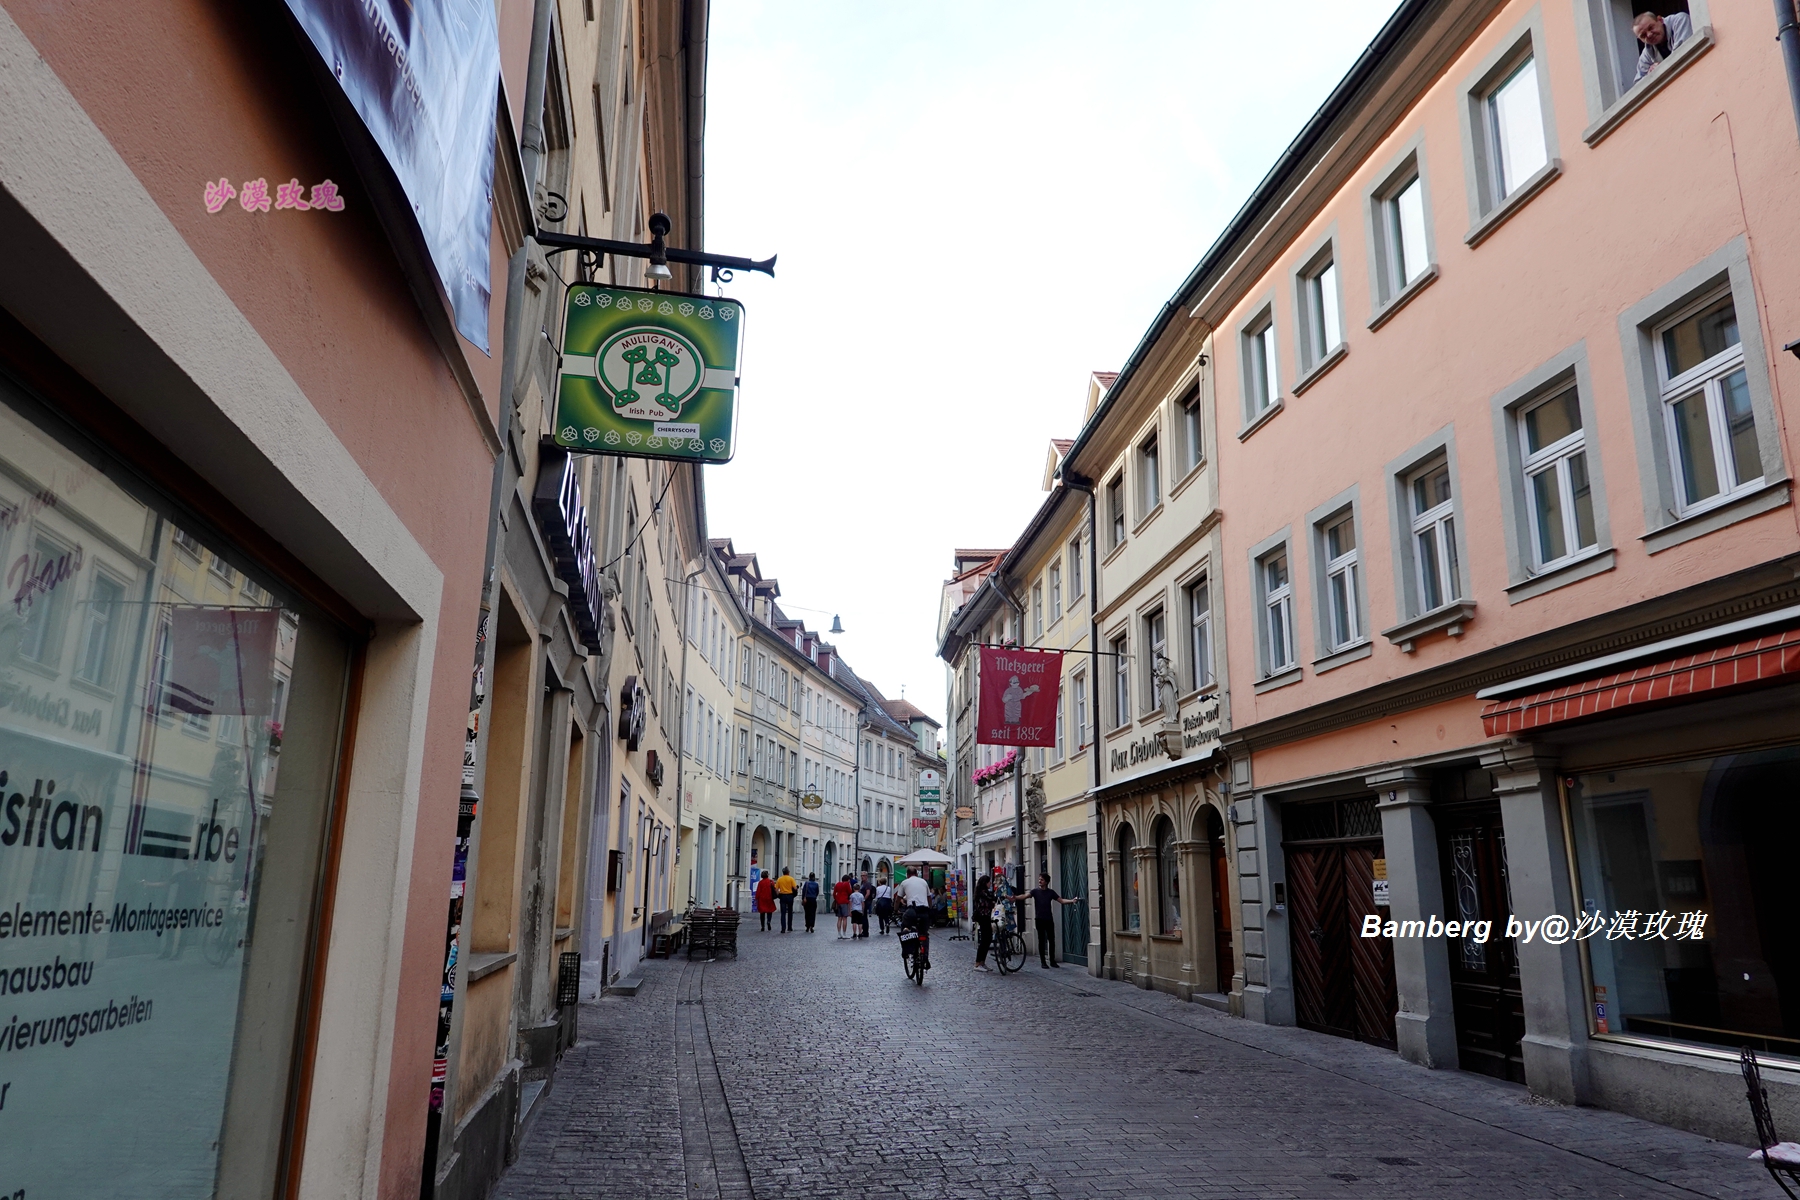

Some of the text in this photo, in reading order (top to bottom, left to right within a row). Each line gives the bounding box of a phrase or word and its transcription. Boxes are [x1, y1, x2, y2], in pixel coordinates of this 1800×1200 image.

[621, 335, 683, 355] MULLIGAN'S
[649, 409, 664, 417] Pub
[657, 426, 696, 434] CHERRYSCOPE
[995, 656, 1045, 675] Metzgerei
[991, 726, 1042, 740] seit 1897
[1110, 748, 1129, 773] Max
[900, 932, 919, 942] SECURITY
